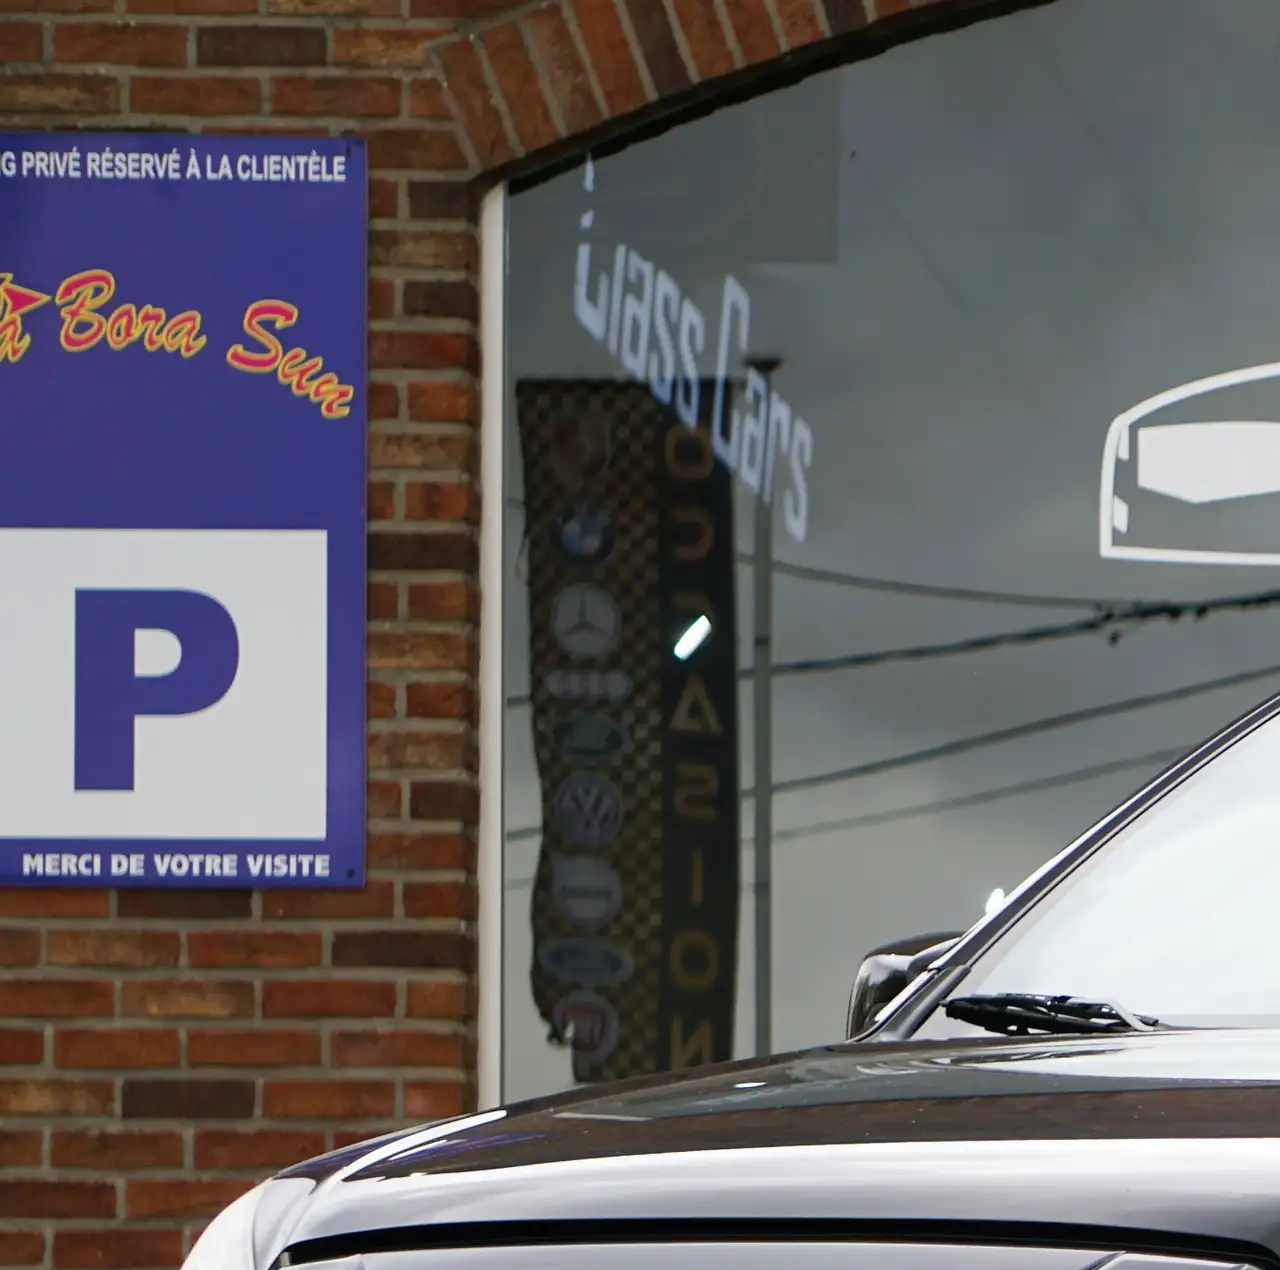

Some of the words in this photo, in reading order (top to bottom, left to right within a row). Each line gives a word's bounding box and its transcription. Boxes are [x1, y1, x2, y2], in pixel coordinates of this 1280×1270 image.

[22, 146, 81, 178] PRIVÉ
[86, 147, 181, 179] RÉSERVÉ
[186, 147, 201, 180] À
[206, 154, 232, 180] LA
[237, 150, 346, 182] CLIENTÈLE
[55, 269, 207, 358] Bora
[226, 299, 354, 419] Sun
[74, 588, 239, 791] P
[22, 853, 100, 877] MERCI
[111, 853, 145, 877] DE
[154, 853, 238, 877] VOTRE
[247, 853, 331, 877] VISITE
